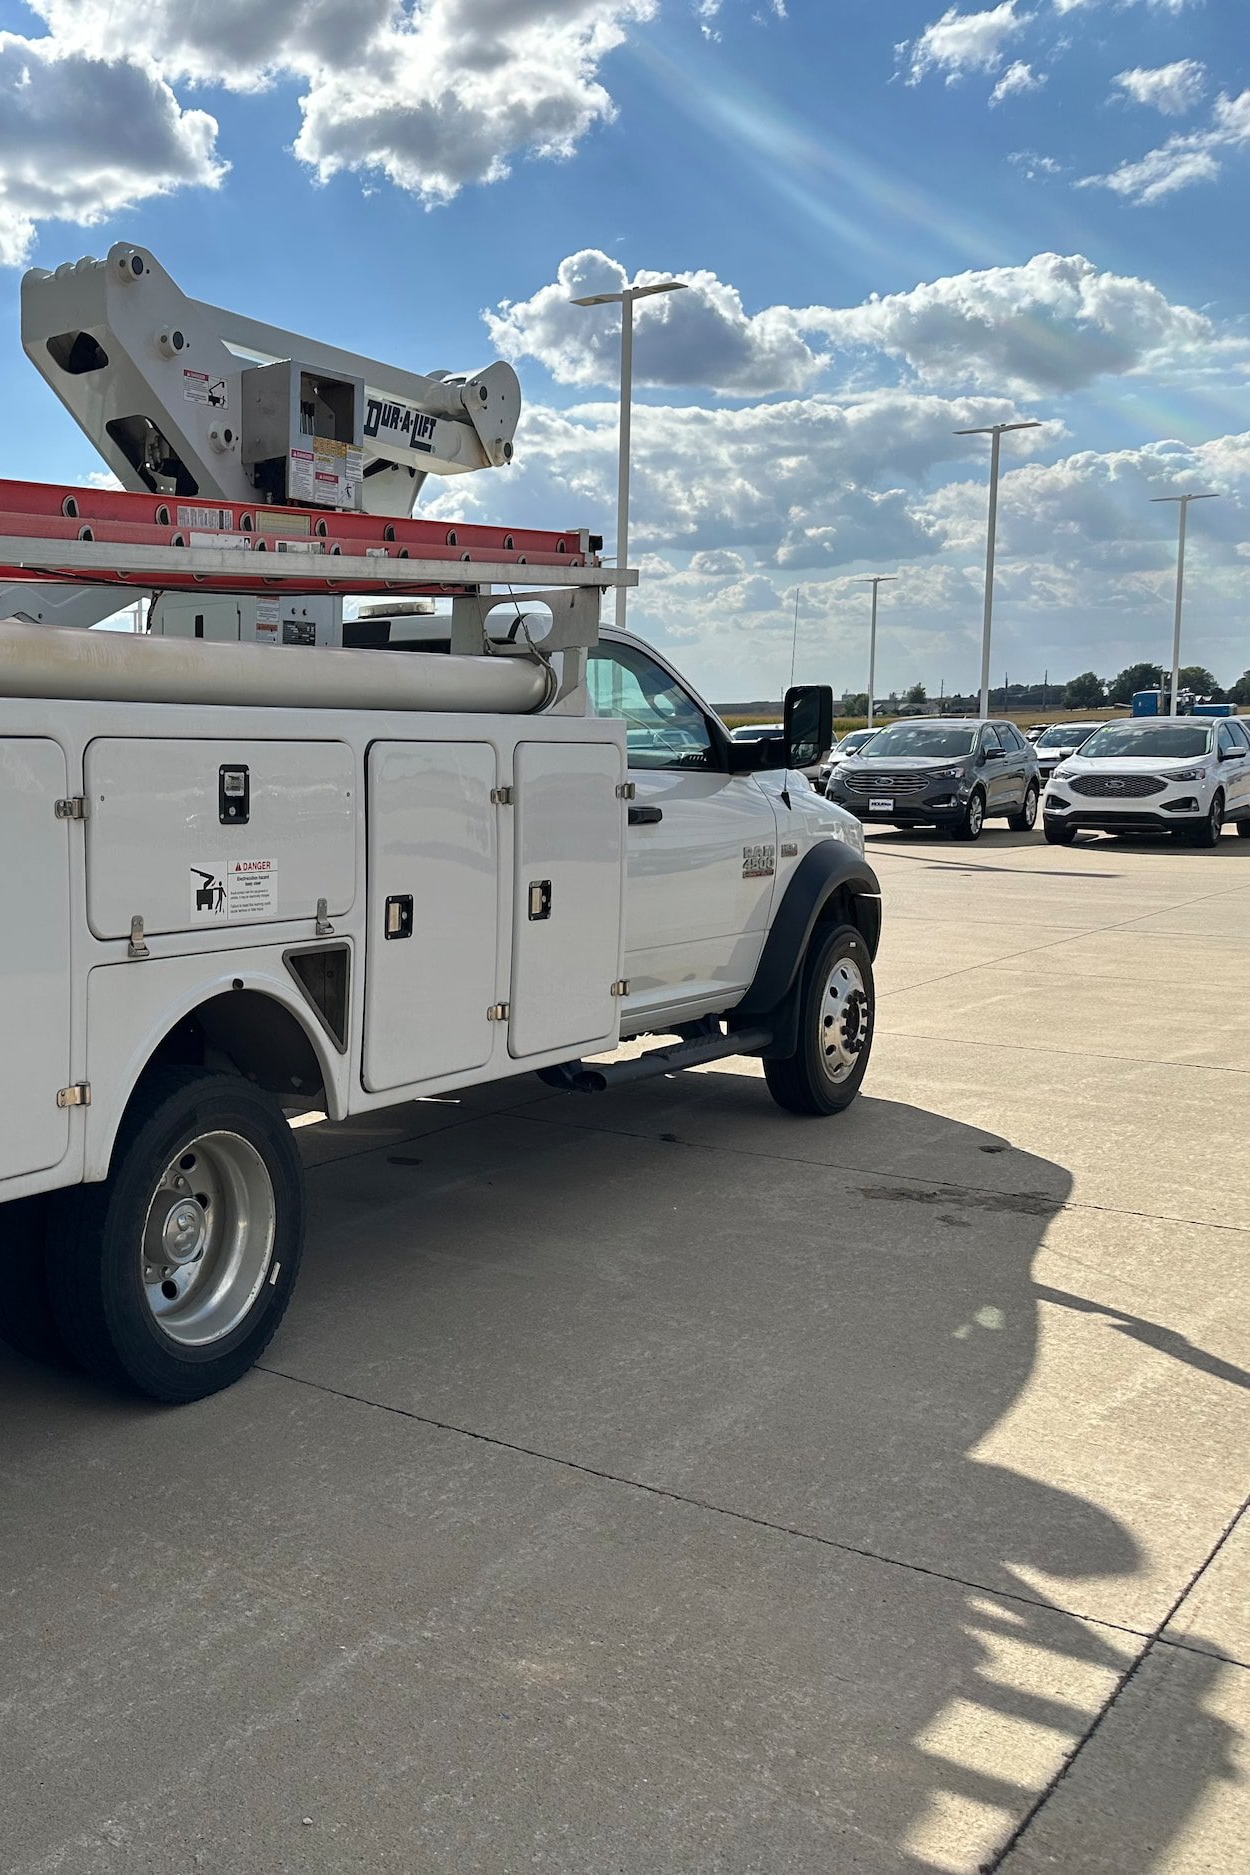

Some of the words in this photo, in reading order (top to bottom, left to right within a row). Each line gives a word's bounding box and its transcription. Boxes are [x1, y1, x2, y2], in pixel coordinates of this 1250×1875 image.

[743, 845, 774, 859] RAM
[243, 861, 271, 870] DANGER
[743, 857, 774, 870] 4500
